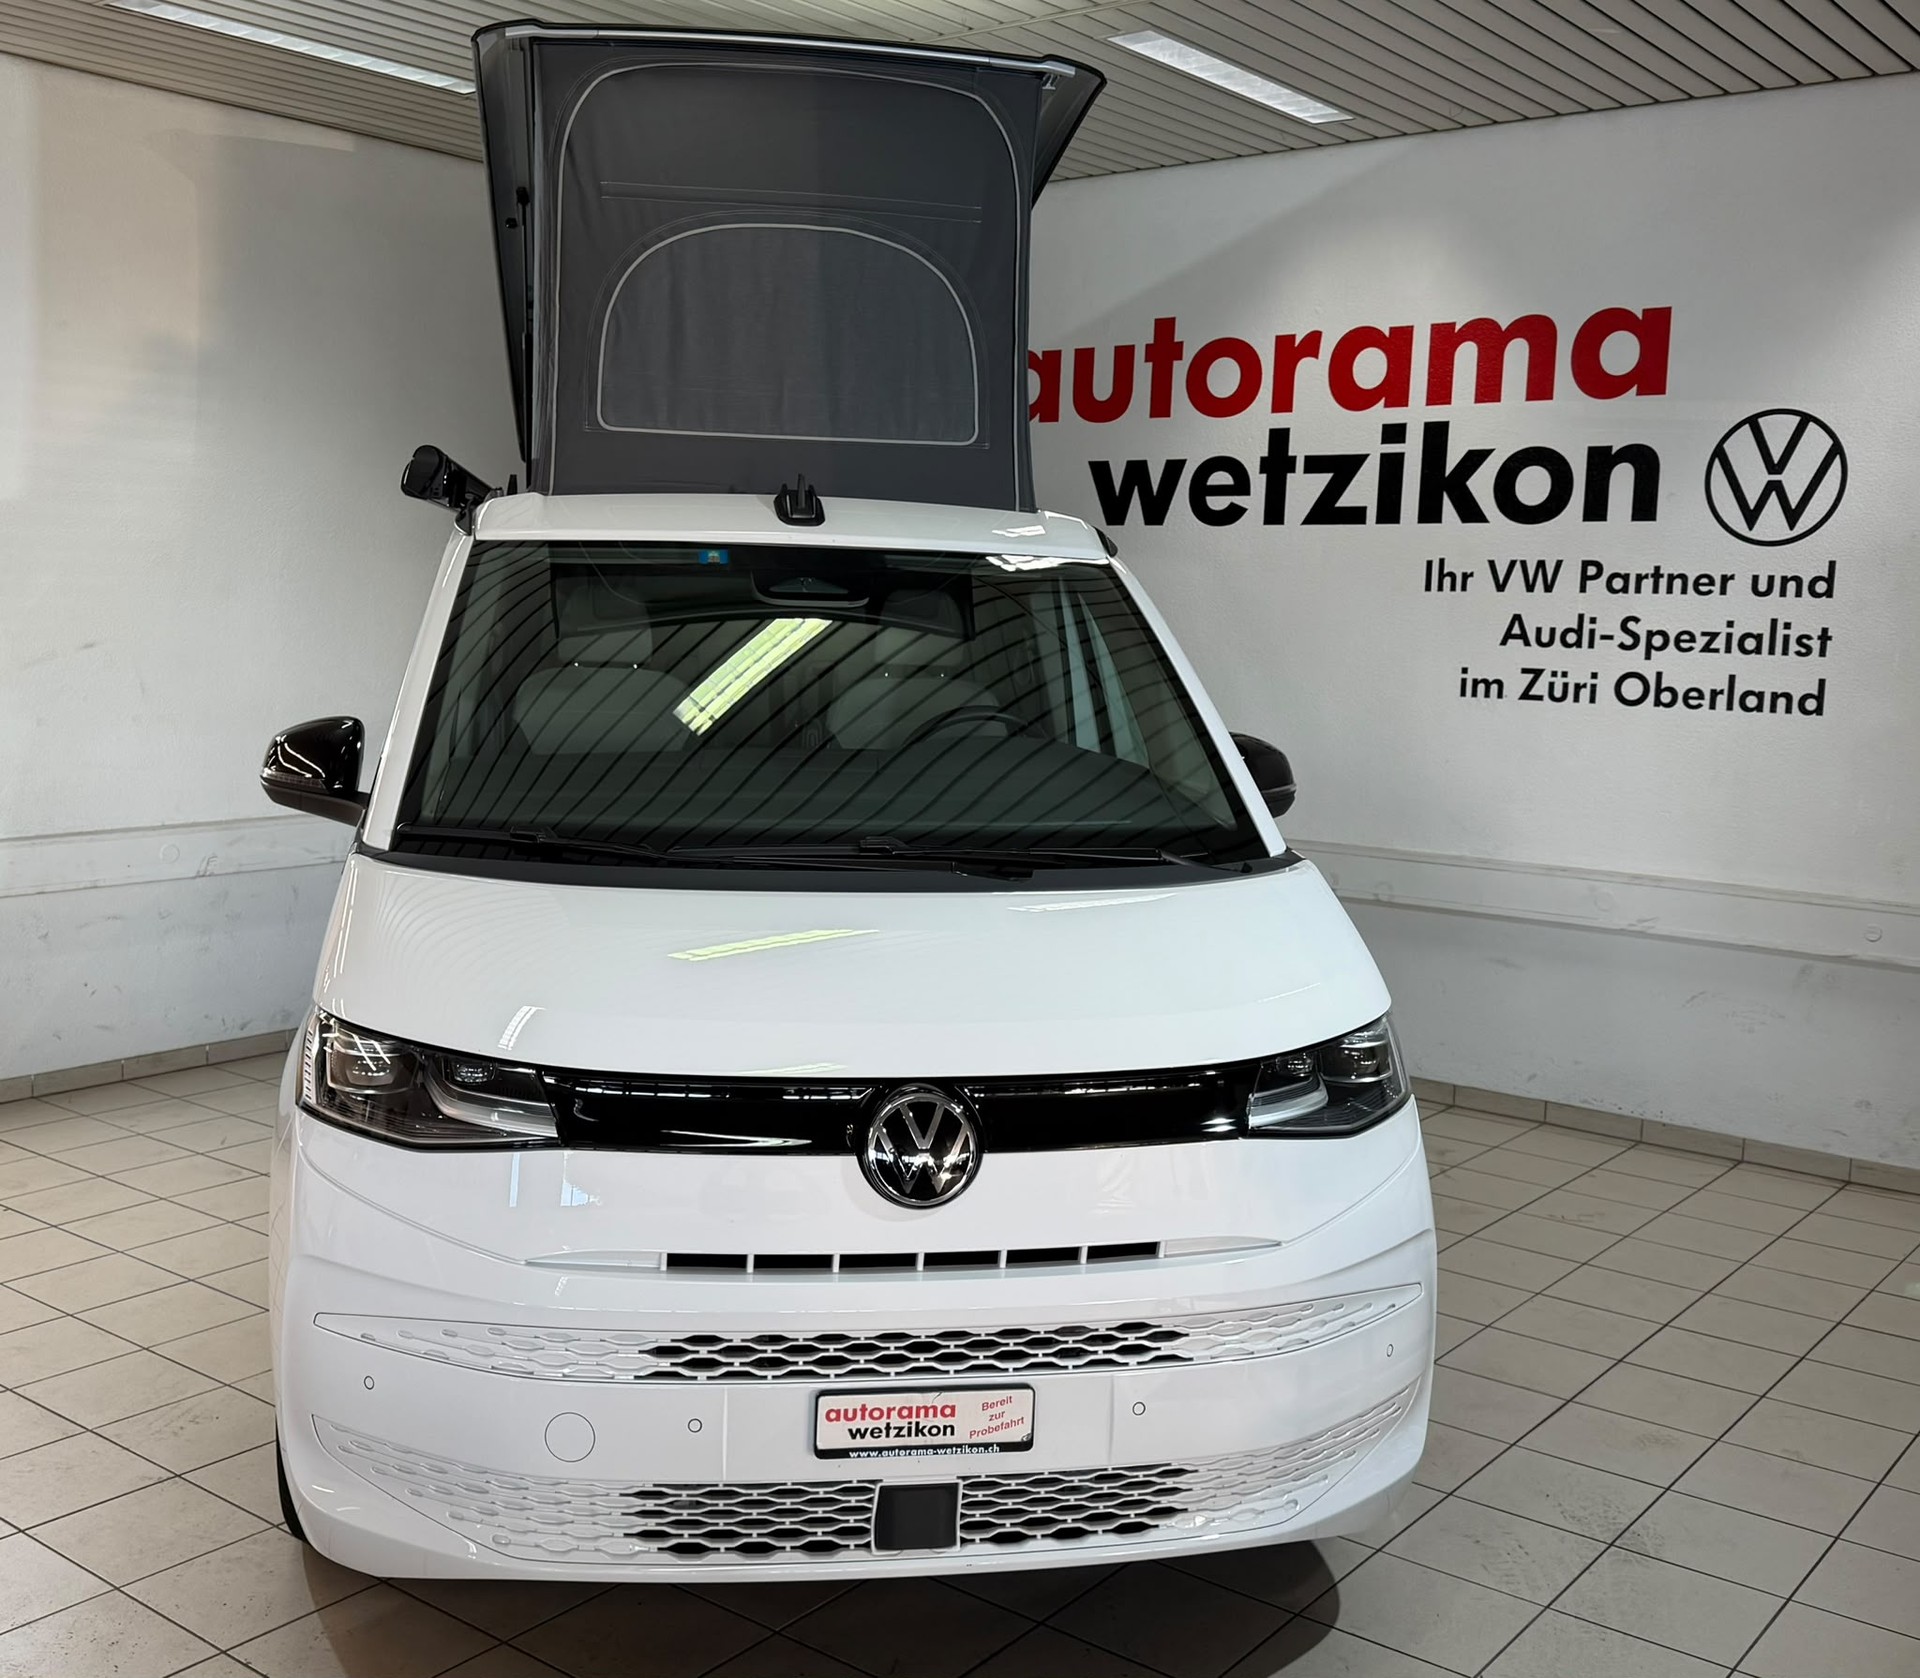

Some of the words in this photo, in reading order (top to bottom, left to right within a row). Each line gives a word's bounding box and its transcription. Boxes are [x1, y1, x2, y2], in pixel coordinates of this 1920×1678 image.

[1088, 420, 1661, 527] wetzikon
[1705, 408, 1848, 547] VW
[1424, 559, 1475, 592] Ihr
[1487, 559, 1564, 594] VW
[1579, 559, 1736, 596] Partner
[1751, 560, 1837, 599] und
[1499, 613, 1833, 661] Audi-Spezialist
[1459, 666, 1504, 700] im
[1518, 667, 1599, 704] Züri
[1613, 671, 1827, 717] Oberland
[824, 1403, 957, 1424] autorama
[981, 1395, 1013, 1412] Bereit
[968, 1416, 1025, 1439] Probefahrt
[988, 1410, 1006, 1422] zur
[847, 1420, 956, 1440] wetzikon
[848, 1443, 1001, 1459] www.autorama-wetzikon.ch
